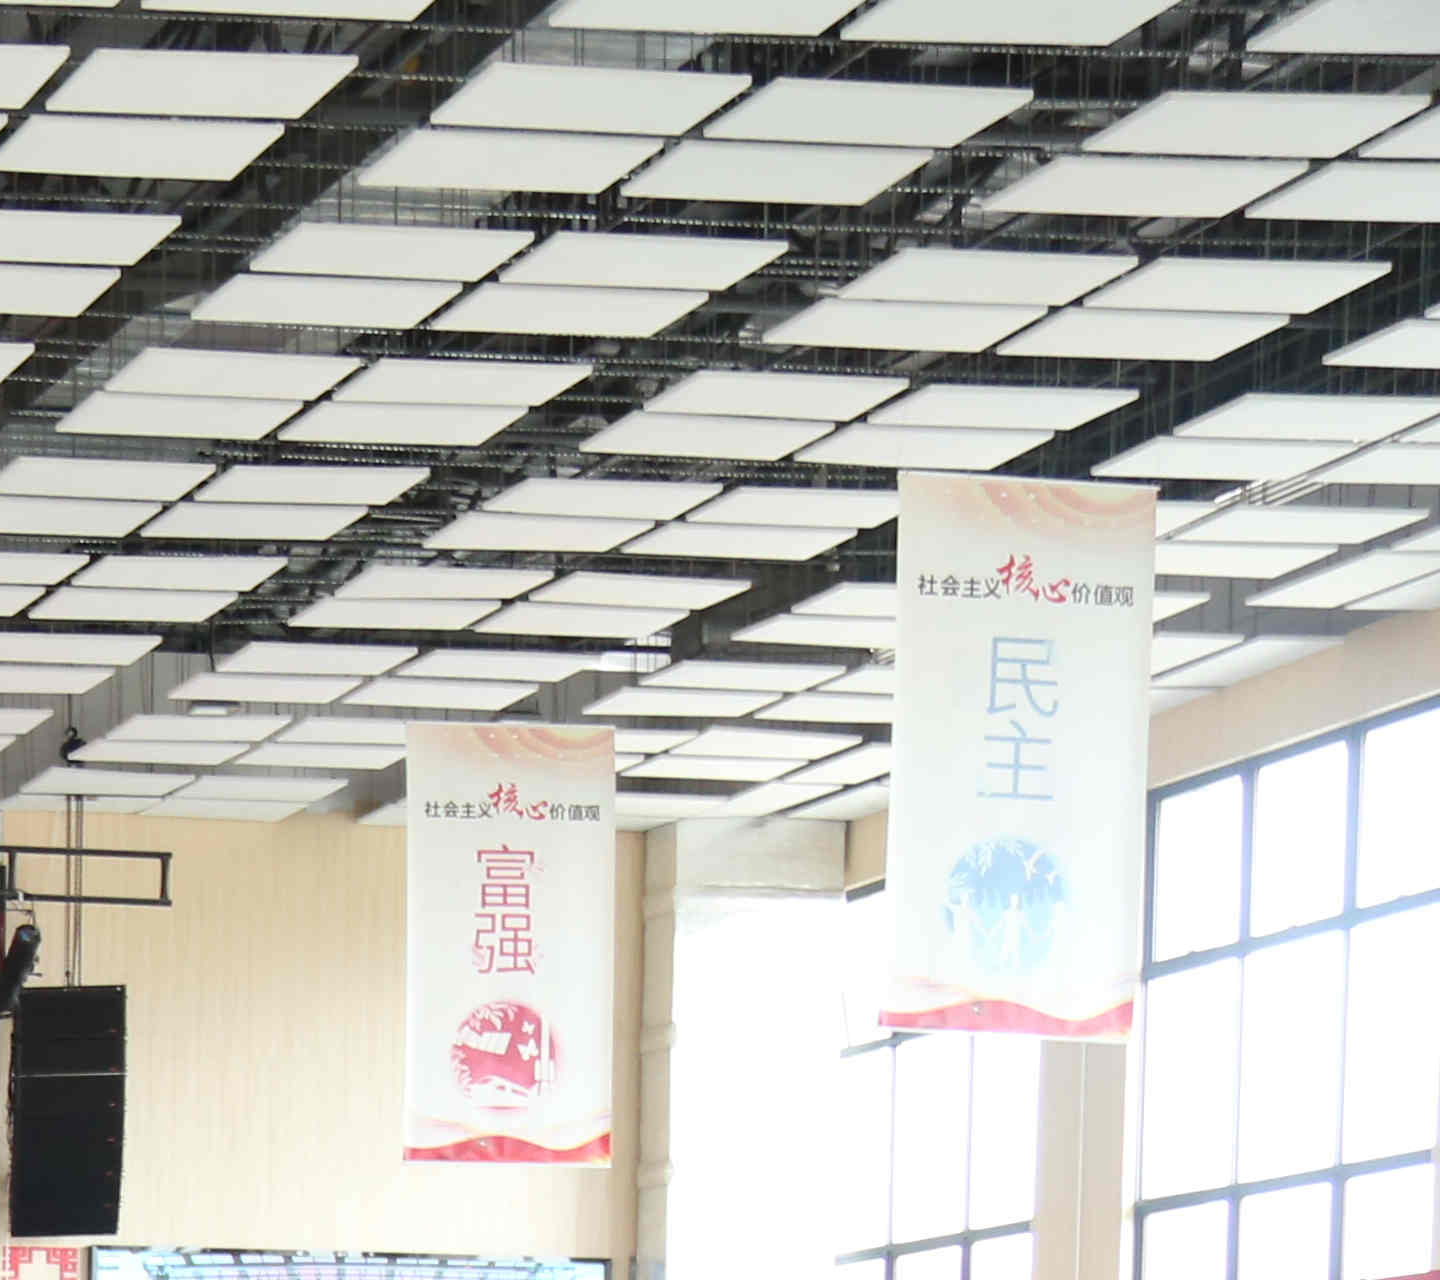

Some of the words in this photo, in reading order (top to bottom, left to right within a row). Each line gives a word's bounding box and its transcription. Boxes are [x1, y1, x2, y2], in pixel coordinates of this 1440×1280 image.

[918, 554, 1135, 607] 社会主义核心价值观
[977, 635, 1059, 801] 民主
[424, 783, 601, 822] 社会主义核心价值观
[473, 844, 536, 975] 富强
